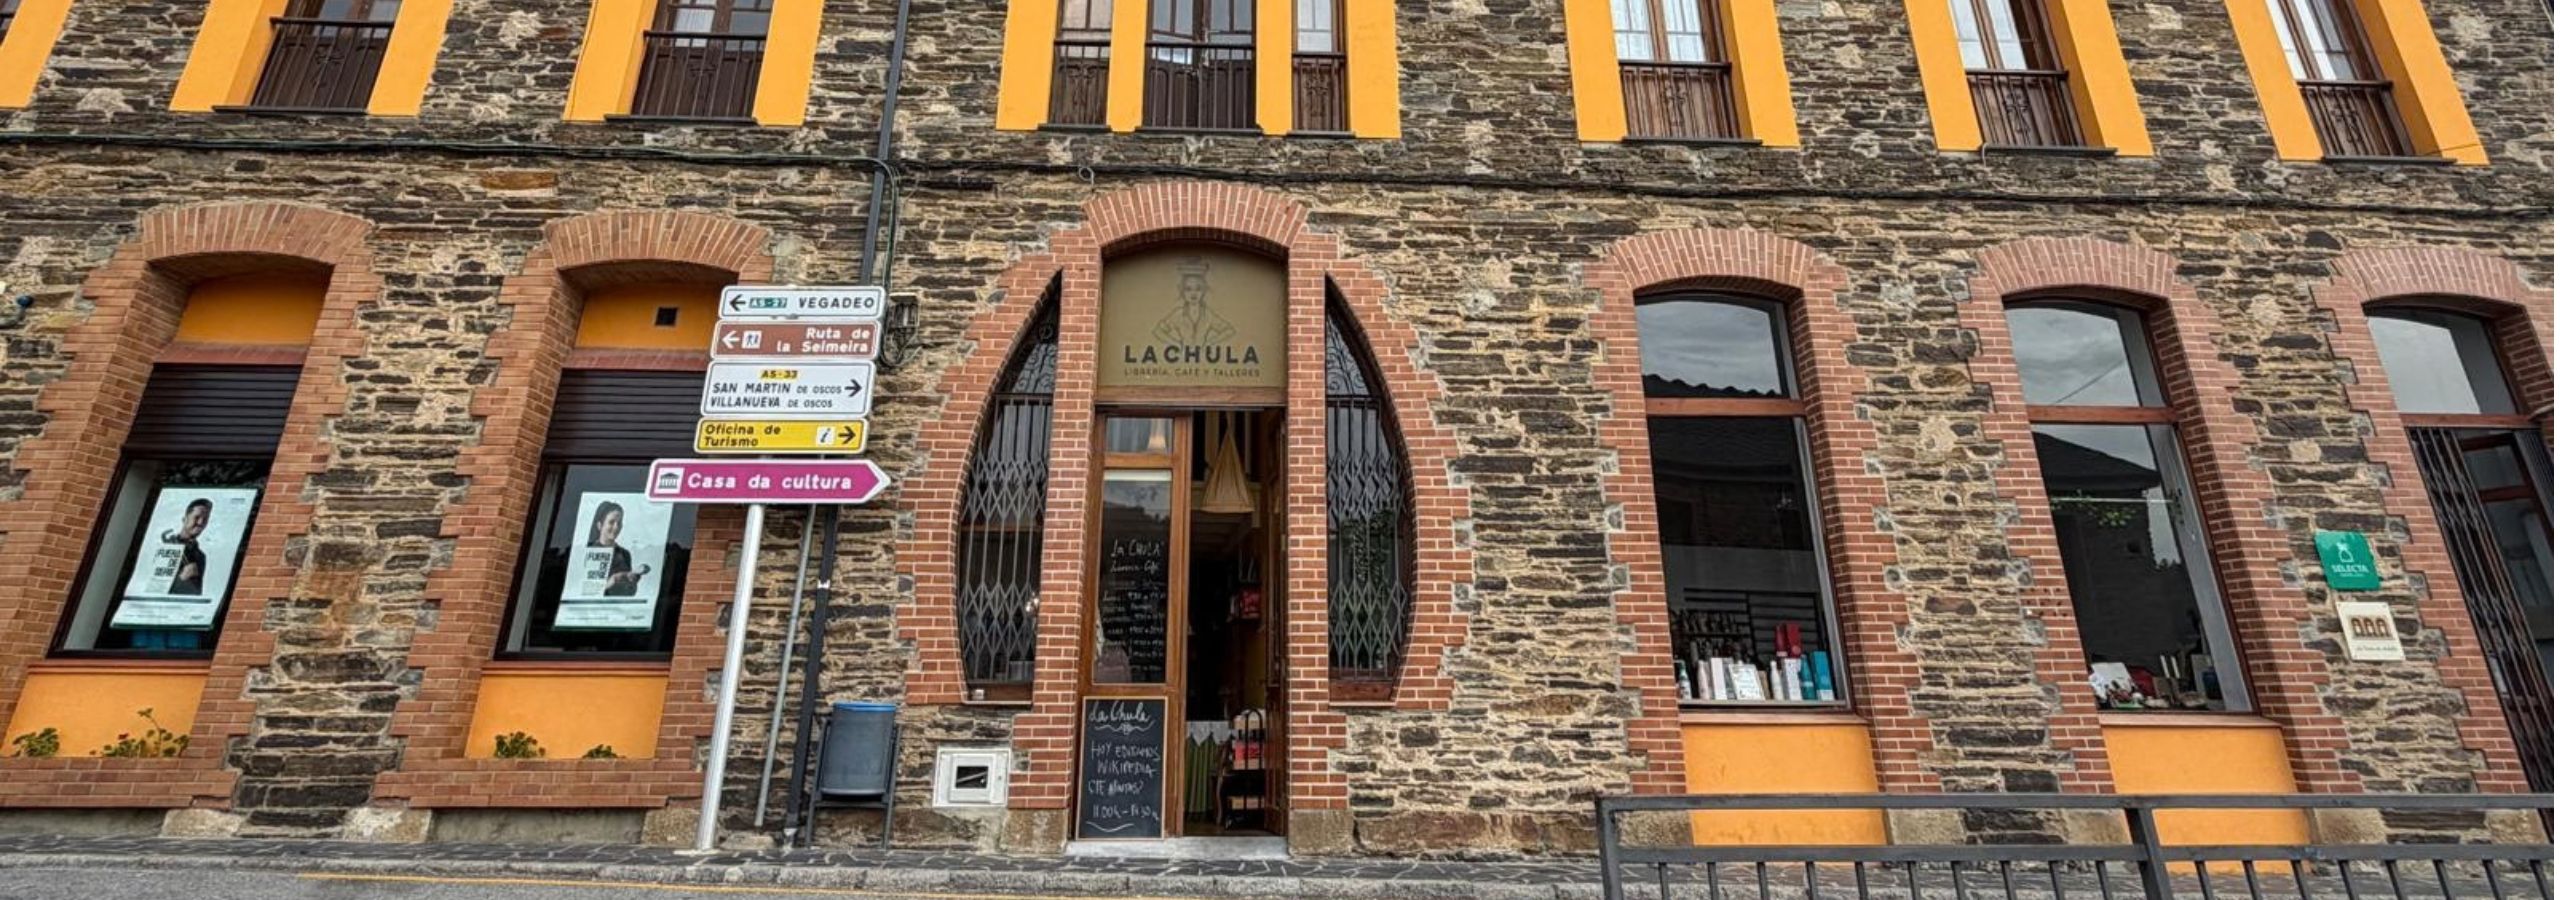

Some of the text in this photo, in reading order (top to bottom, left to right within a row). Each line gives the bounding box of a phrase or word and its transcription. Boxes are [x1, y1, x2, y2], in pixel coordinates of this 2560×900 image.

[799, 297, 874, 308] VEGADEO
[806, 327, 870, 339] Ruta de
[777, 341, 868, 352] la Seimeira
[761, 370, 798, 379] AS-33
[1214, 368, 1260, 377] TALLERES
[713, 383, 842, 394] SAN MARTIN DE OSCOS
[711, 397, 832, 408] VILLANUEVA DE OSCOS
[705, 424, 781, 434] Oficina de
[704, 437, 758, 446] Turismo
[687, 473, 852, 489] Casa da cultura
[2331, 564, 2370, 573] SELECTA
[1110, 700, 1151, 722] Chula
